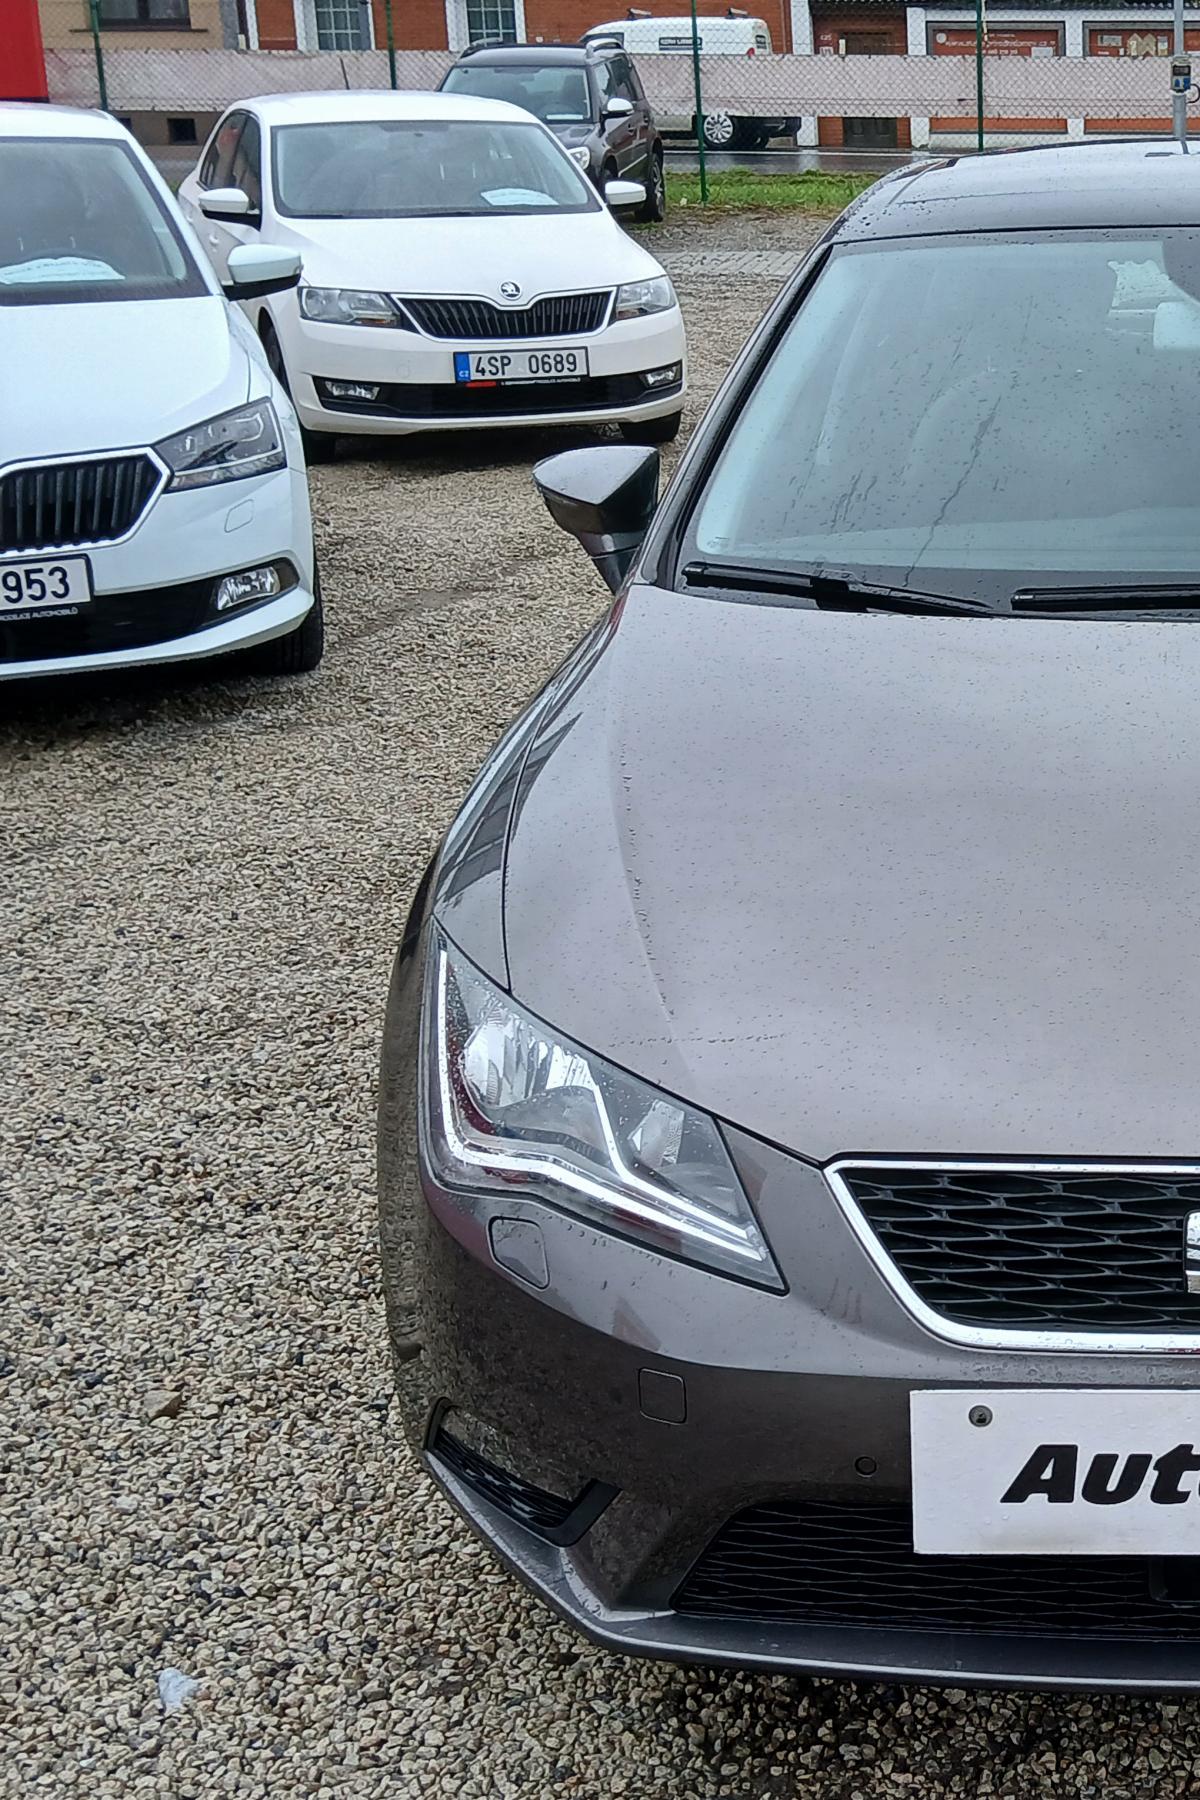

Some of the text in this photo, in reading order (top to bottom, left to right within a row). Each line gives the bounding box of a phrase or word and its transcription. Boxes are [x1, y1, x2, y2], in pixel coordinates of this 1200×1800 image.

[475, 355, 512, 376] 4SP
[528, 353, 577, 374] 0689
[2, 566, 70, 604] 953
